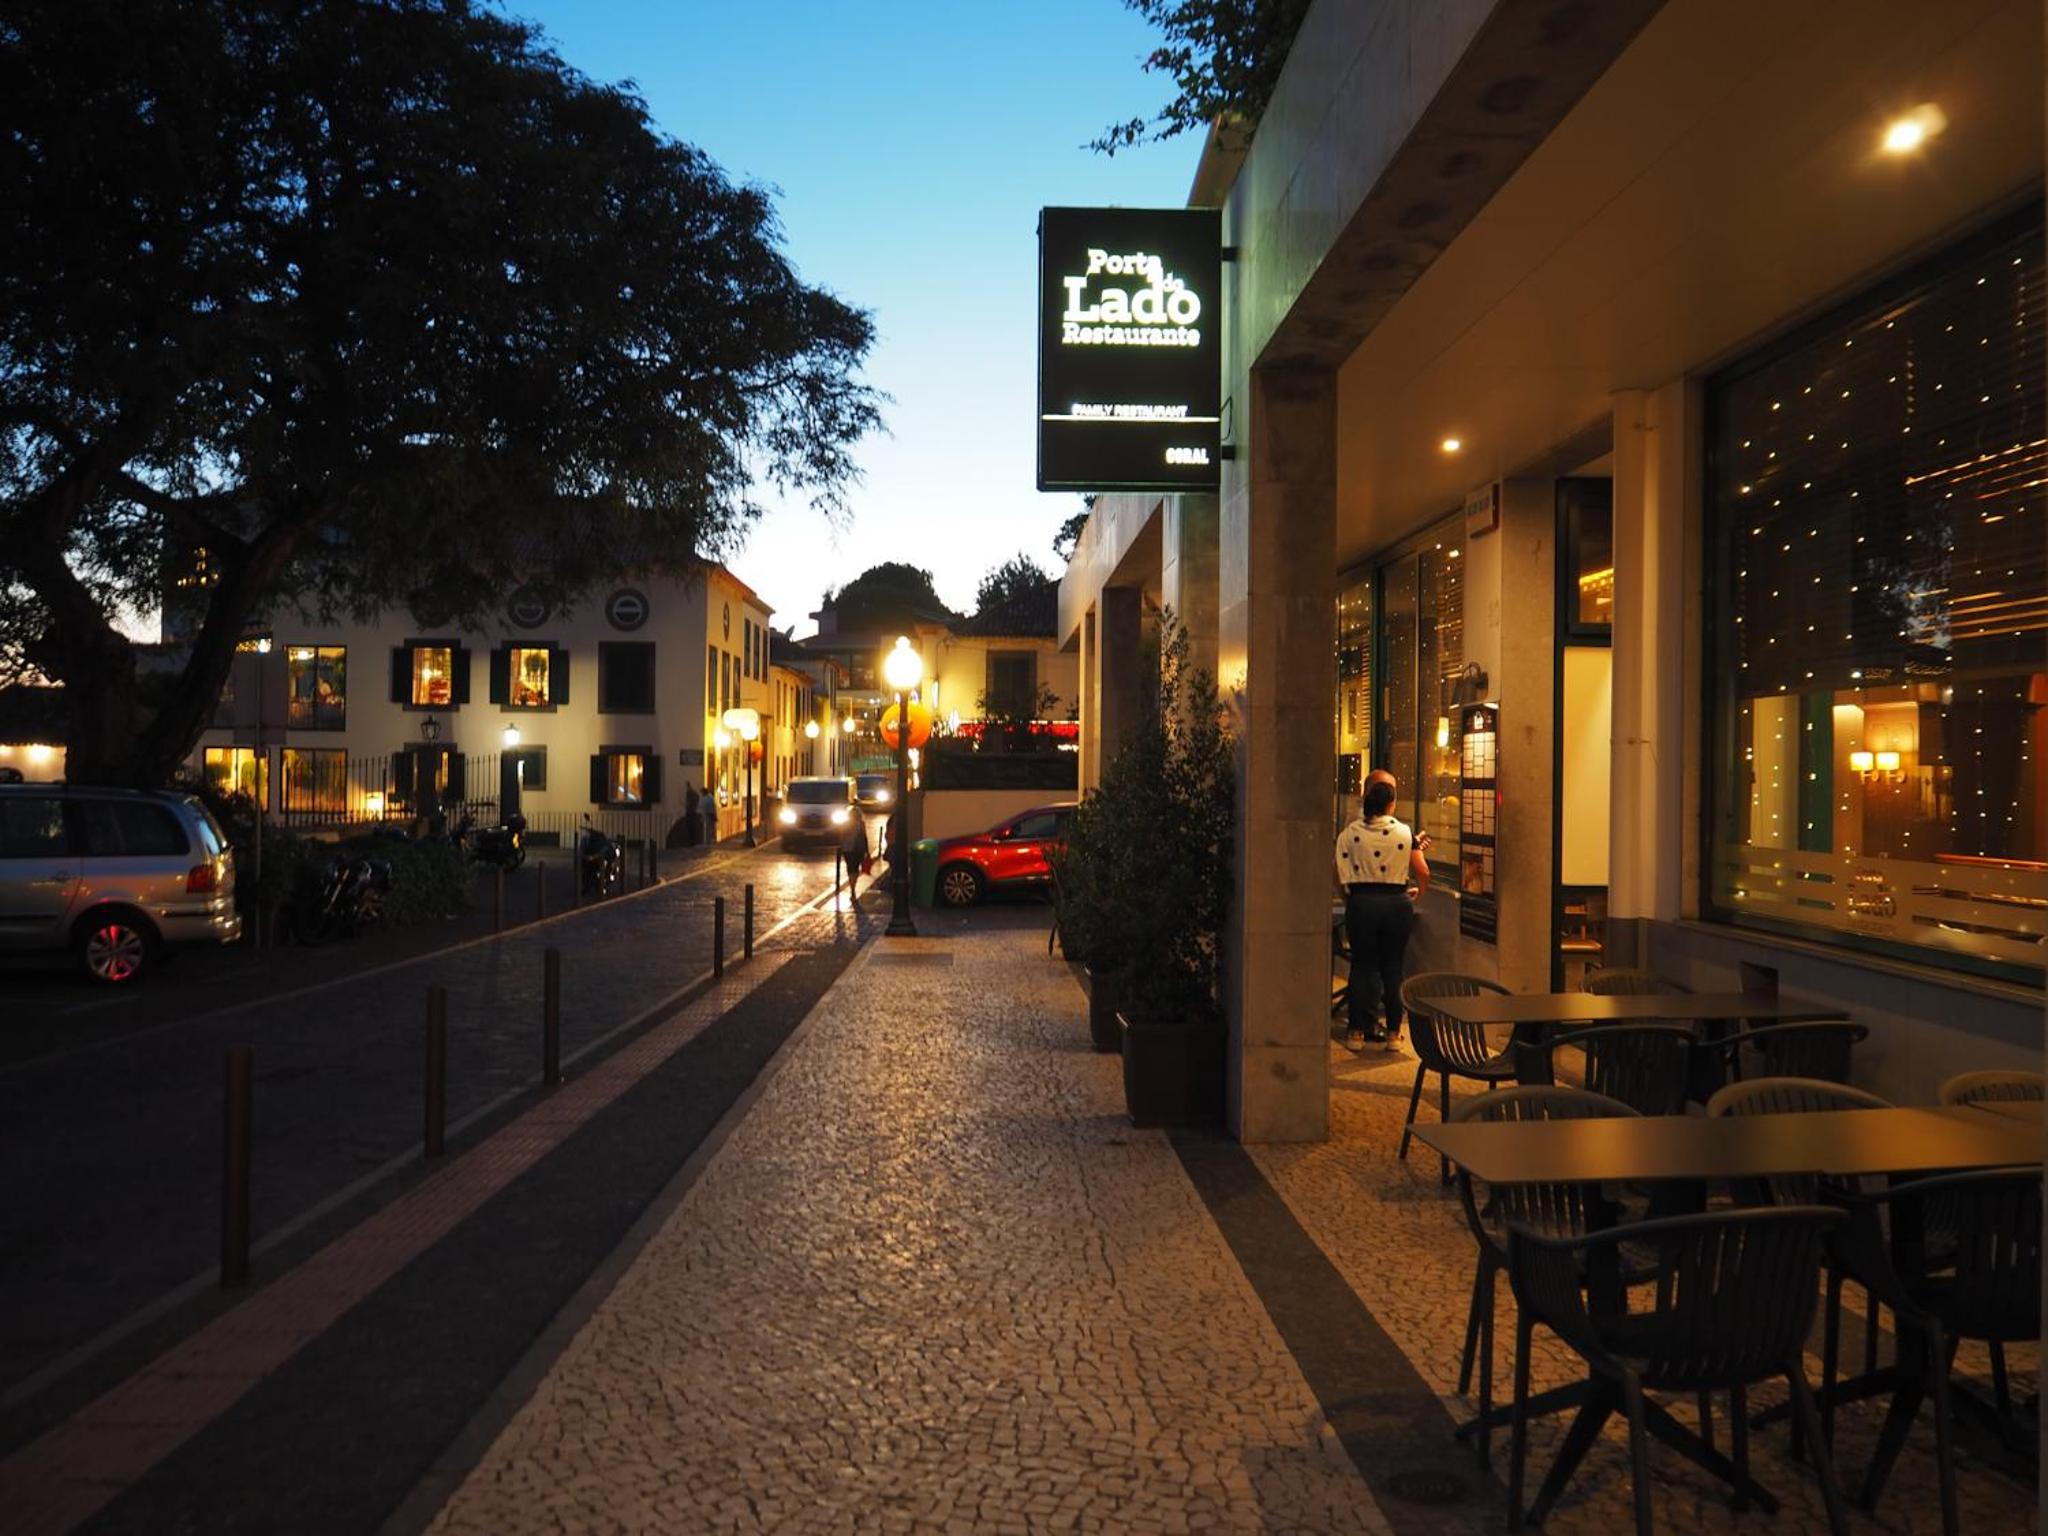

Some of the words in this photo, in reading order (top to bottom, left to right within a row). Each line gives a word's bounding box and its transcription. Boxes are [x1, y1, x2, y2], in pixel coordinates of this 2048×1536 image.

[1086, 248, 1162, 281] Porta
[1163, 271, 1184, 292] do
[1063, 274, 1201, 325] Lado
[1062, 322, 1200, 346] Restaurante
[1071, 404, 1113, 417] FAMILY
[1114, 404, 1188, 418] RESTAURANT
[1165, 447, 1209, 464] CORAL
